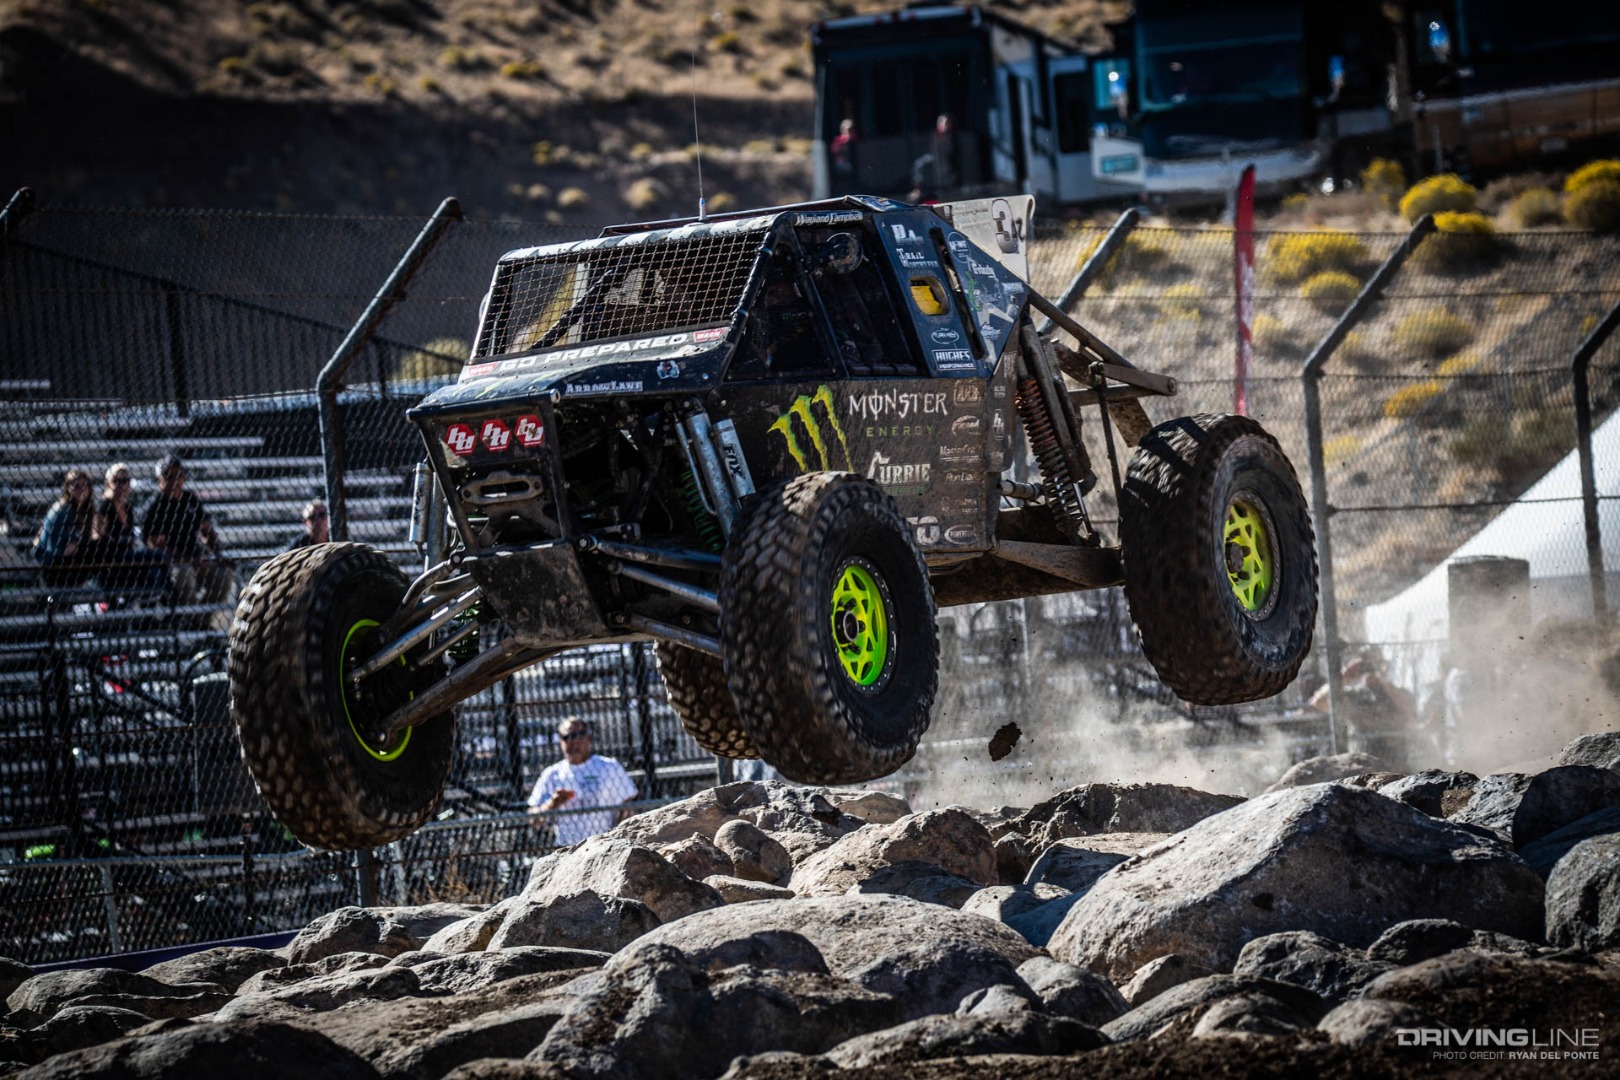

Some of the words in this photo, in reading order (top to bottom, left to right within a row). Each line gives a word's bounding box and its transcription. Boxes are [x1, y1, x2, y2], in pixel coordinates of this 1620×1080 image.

[544, 333, 688, 363] PREPARED
[936, 351, 971, 361] HUGHES
[866, 426, 934, 437] ENERGY
